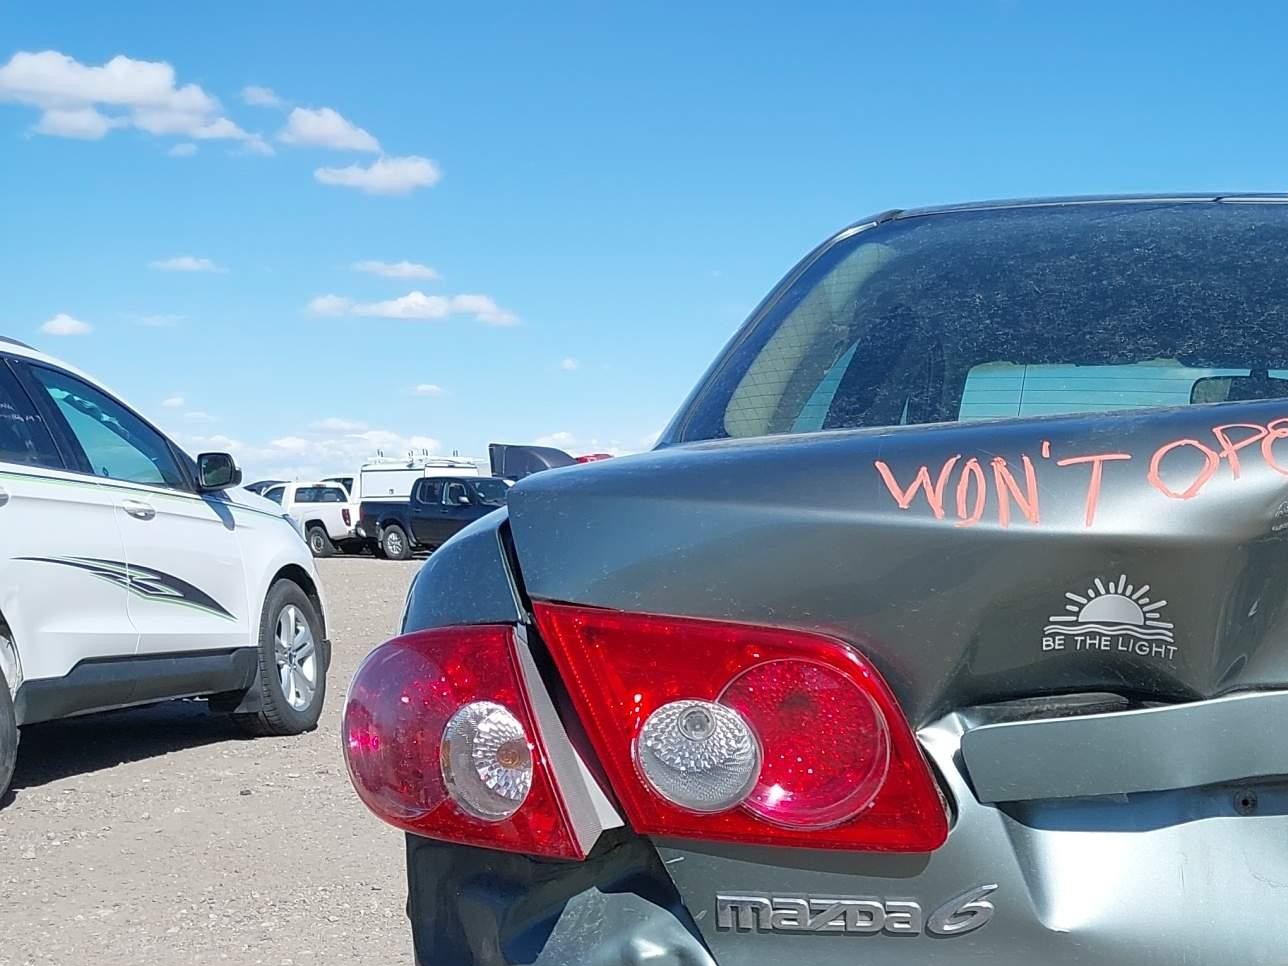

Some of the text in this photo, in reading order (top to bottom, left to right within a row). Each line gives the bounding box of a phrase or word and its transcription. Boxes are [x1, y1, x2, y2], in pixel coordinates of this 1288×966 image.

[874, 440, 1132, 528] WON'T
[1042, 635, 1178, 660] BE THE LIGHT
[925, 883, 999, 936] 6
